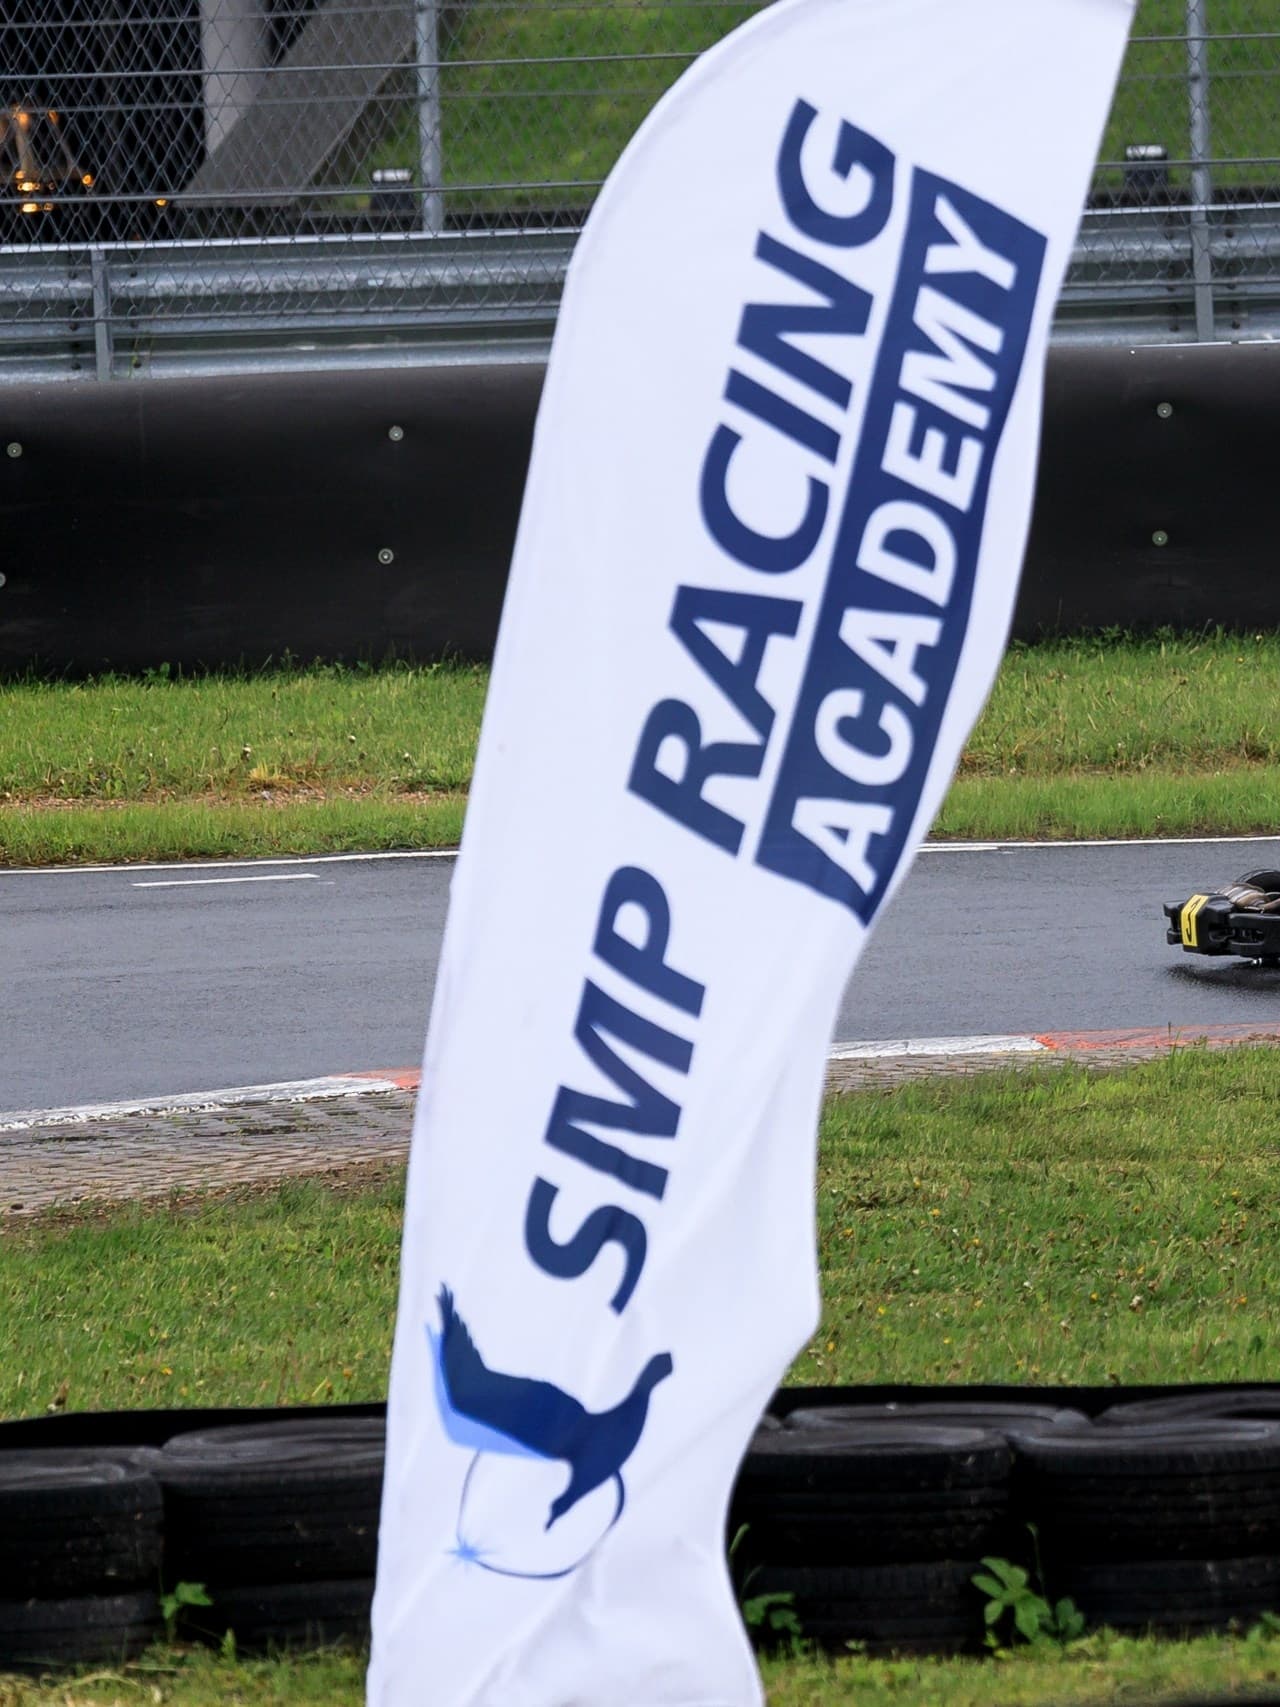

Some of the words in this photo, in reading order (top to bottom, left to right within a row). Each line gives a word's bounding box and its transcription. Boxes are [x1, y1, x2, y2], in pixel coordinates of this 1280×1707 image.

[523, 865, 706, 1316] SMP
[626, 96, 897, 858] RACING
[791, 194, 1018, 895] ACADEMY
